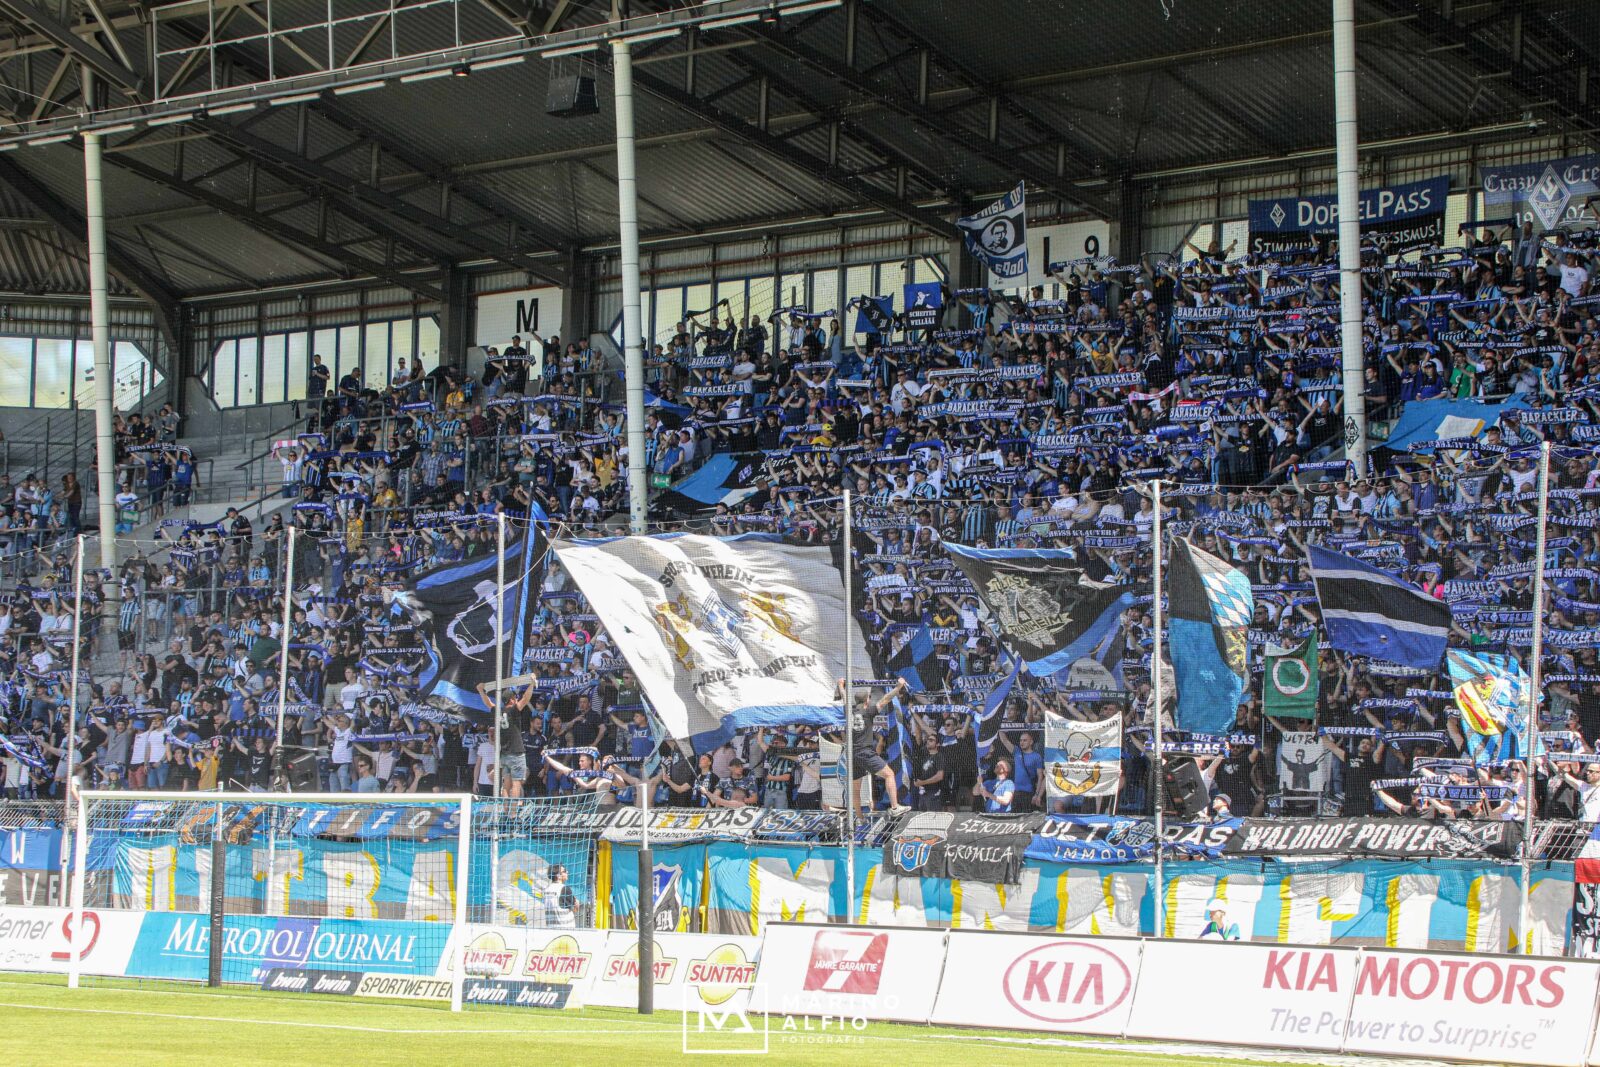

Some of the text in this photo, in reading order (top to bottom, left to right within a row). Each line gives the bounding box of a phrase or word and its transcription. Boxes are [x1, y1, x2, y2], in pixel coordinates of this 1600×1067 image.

[1484, 175, 1536, 193] Crazy
[516, 298, 539, 332] M
[1520, 410, 1577, 424] BARACKLER
[1037, 434, 1080, 446] BARACKLER
[1324, 727, 1376, 736] KURPFALZ
[1352, 822, 1448, 850] POWER
[528, 955, 586, 974] SUNTAT
[689, 964, 755, 984] SUNTAT
[271, 971, 309, 991] bwin
[313, 974, 352, 992] bwin
[1022, 960, 1104, 1006] KIA
[1263, 950, 1566, 1008] KIA MOTORS
[467, 982, 559, 1005] bwin bwin
[1269, 1008, 1312, 1034] The
[1314, 1010, 1395, 1042] Power
[1399, 1020, 1424, 1042] to
[1428, 1019, 1538, 1051] Surprise
